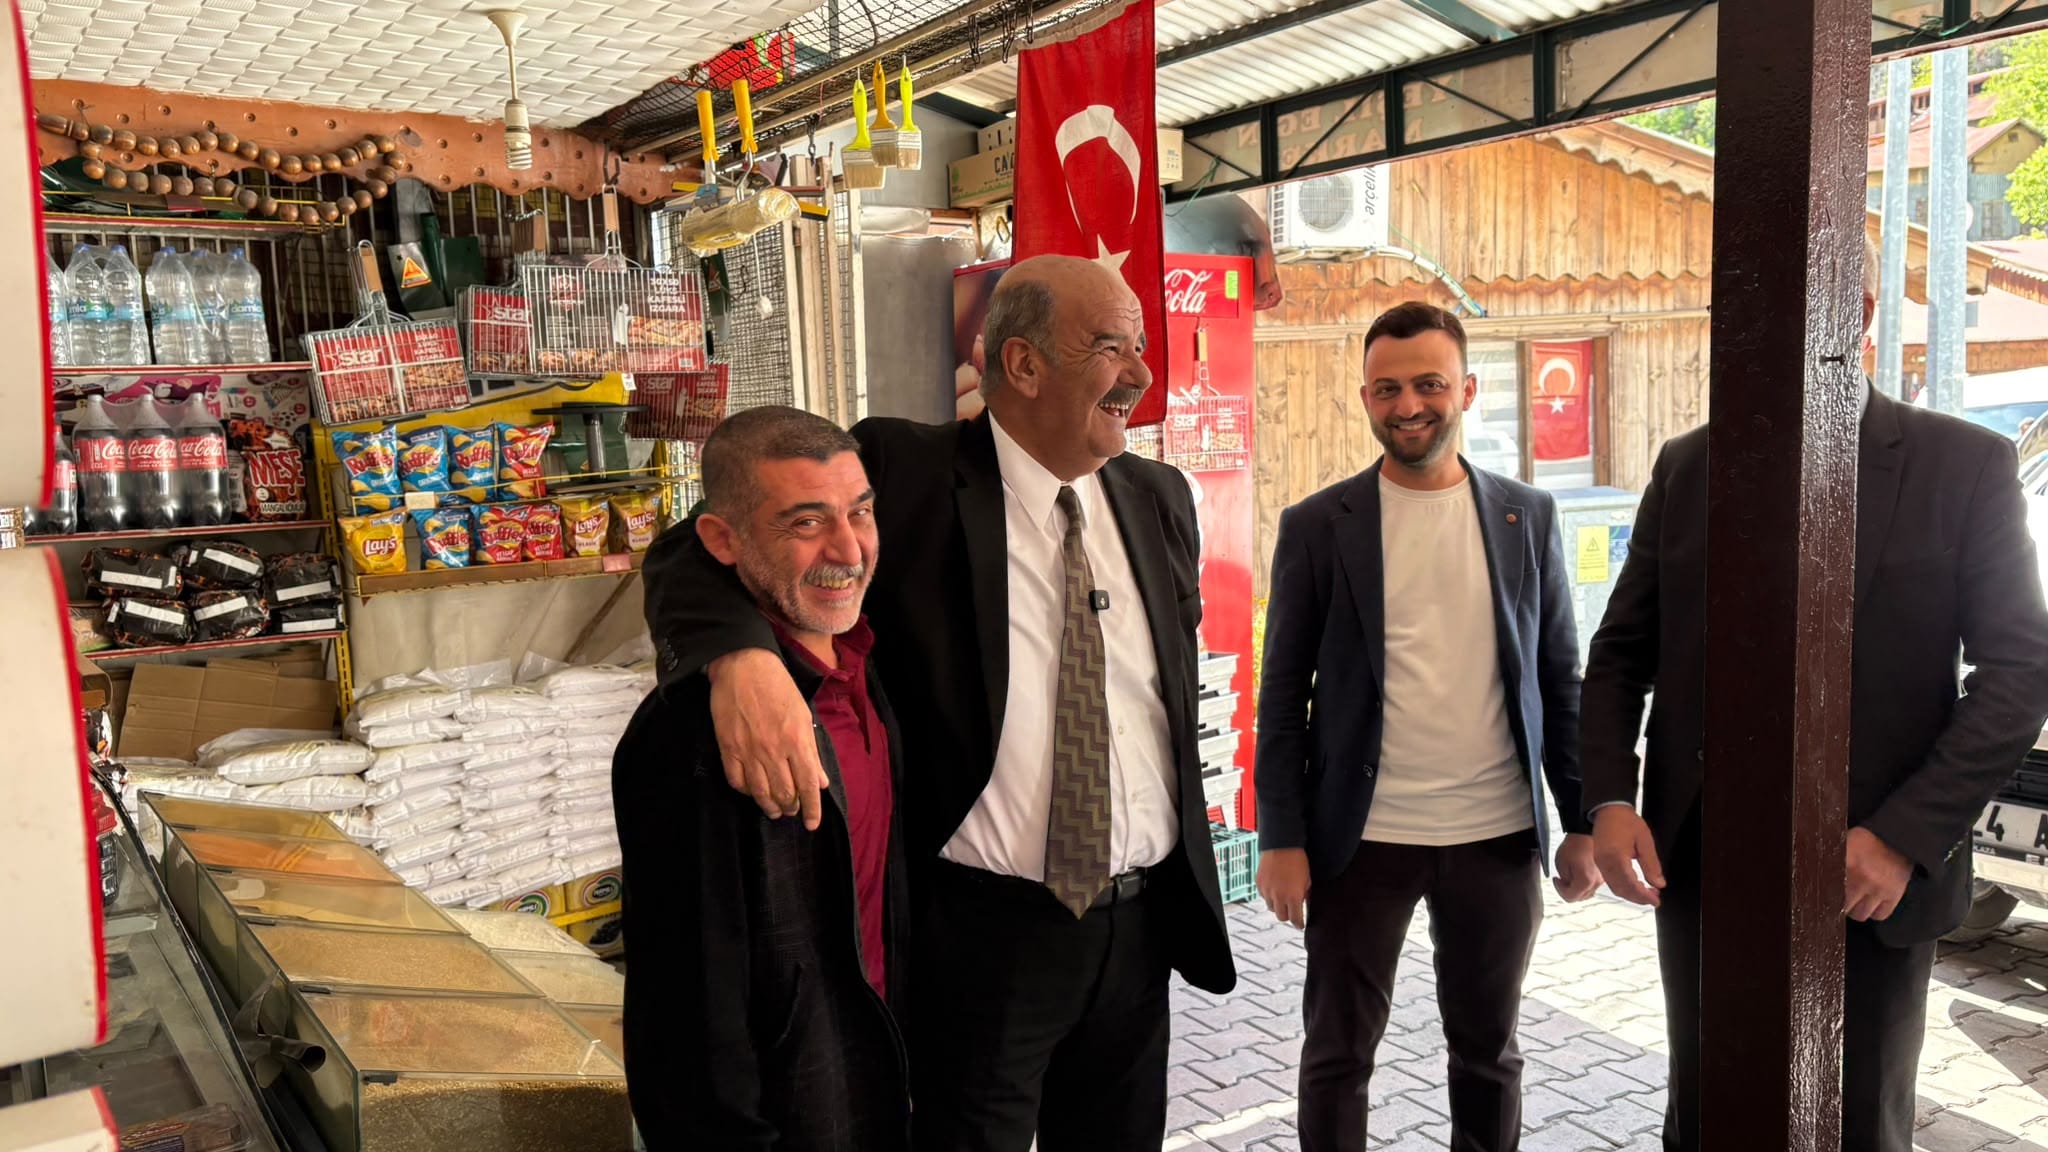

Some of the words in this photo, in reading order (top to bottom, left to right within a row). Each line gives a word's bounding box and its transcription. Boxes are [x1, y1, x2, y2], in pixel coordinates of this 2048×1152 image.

[340, 347, 382, 367] star
[454, 446, 493, 469] Ruffle
[575, 515, 599, 534] Lay's
[627, 511, 652, 530] Lay's
[364, 536, 396, 557] Lay's
